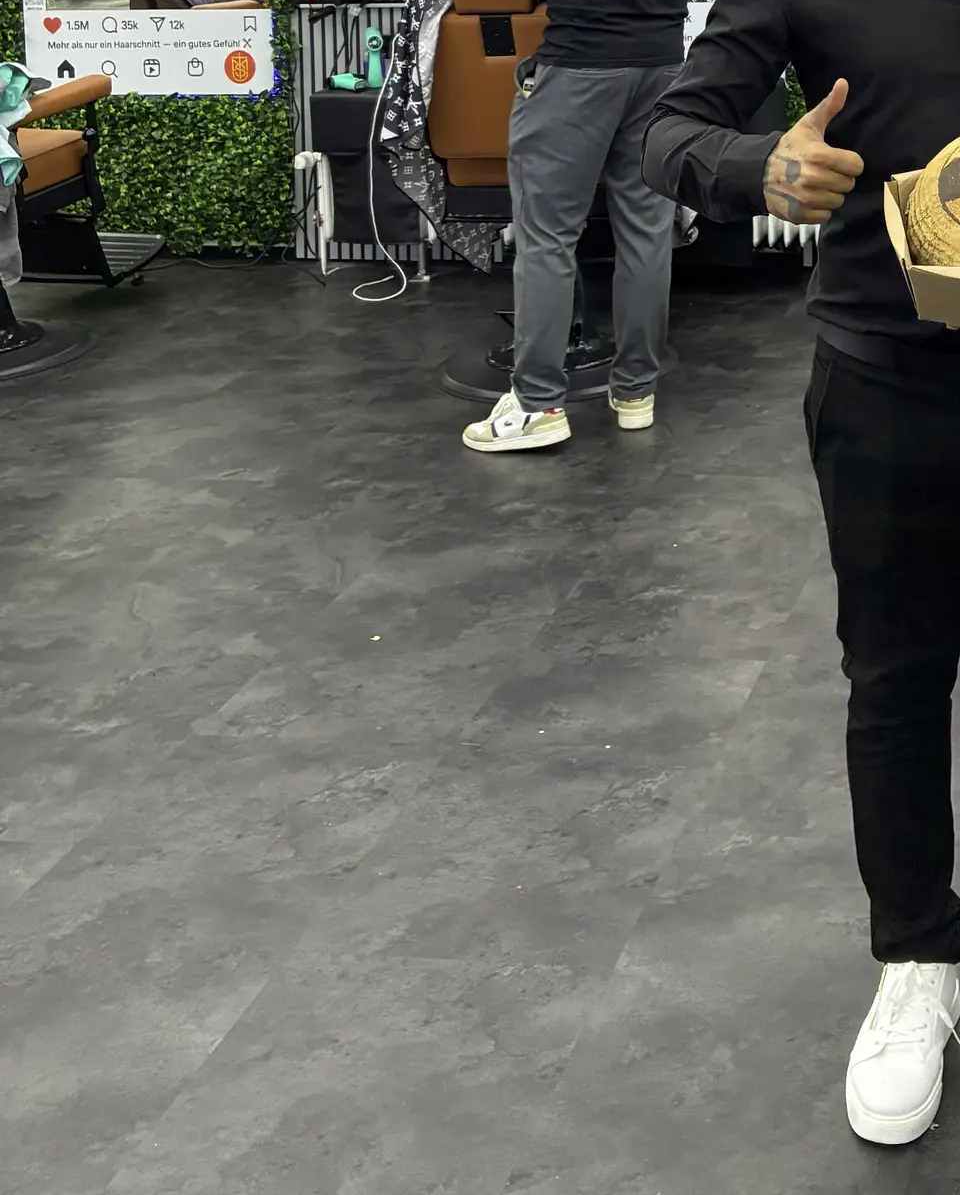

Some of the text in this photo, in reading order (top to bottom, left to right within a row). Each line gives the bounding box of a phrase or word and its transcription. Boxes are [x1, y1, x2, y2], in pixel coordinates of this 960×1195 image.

[66, 20, 185, 31] 1.5M 35k 12k
[47, 41, 70, 49] Mehr
[71, 40, 83, 49] als
[99, 40, 113, 49] ein
[113, 39, 161, 49] Haarschnitt
[173, 40, 187, 49] ein
[188, 40, 212, 50] gutes
[212, 39, 241, 49] Gefühl
